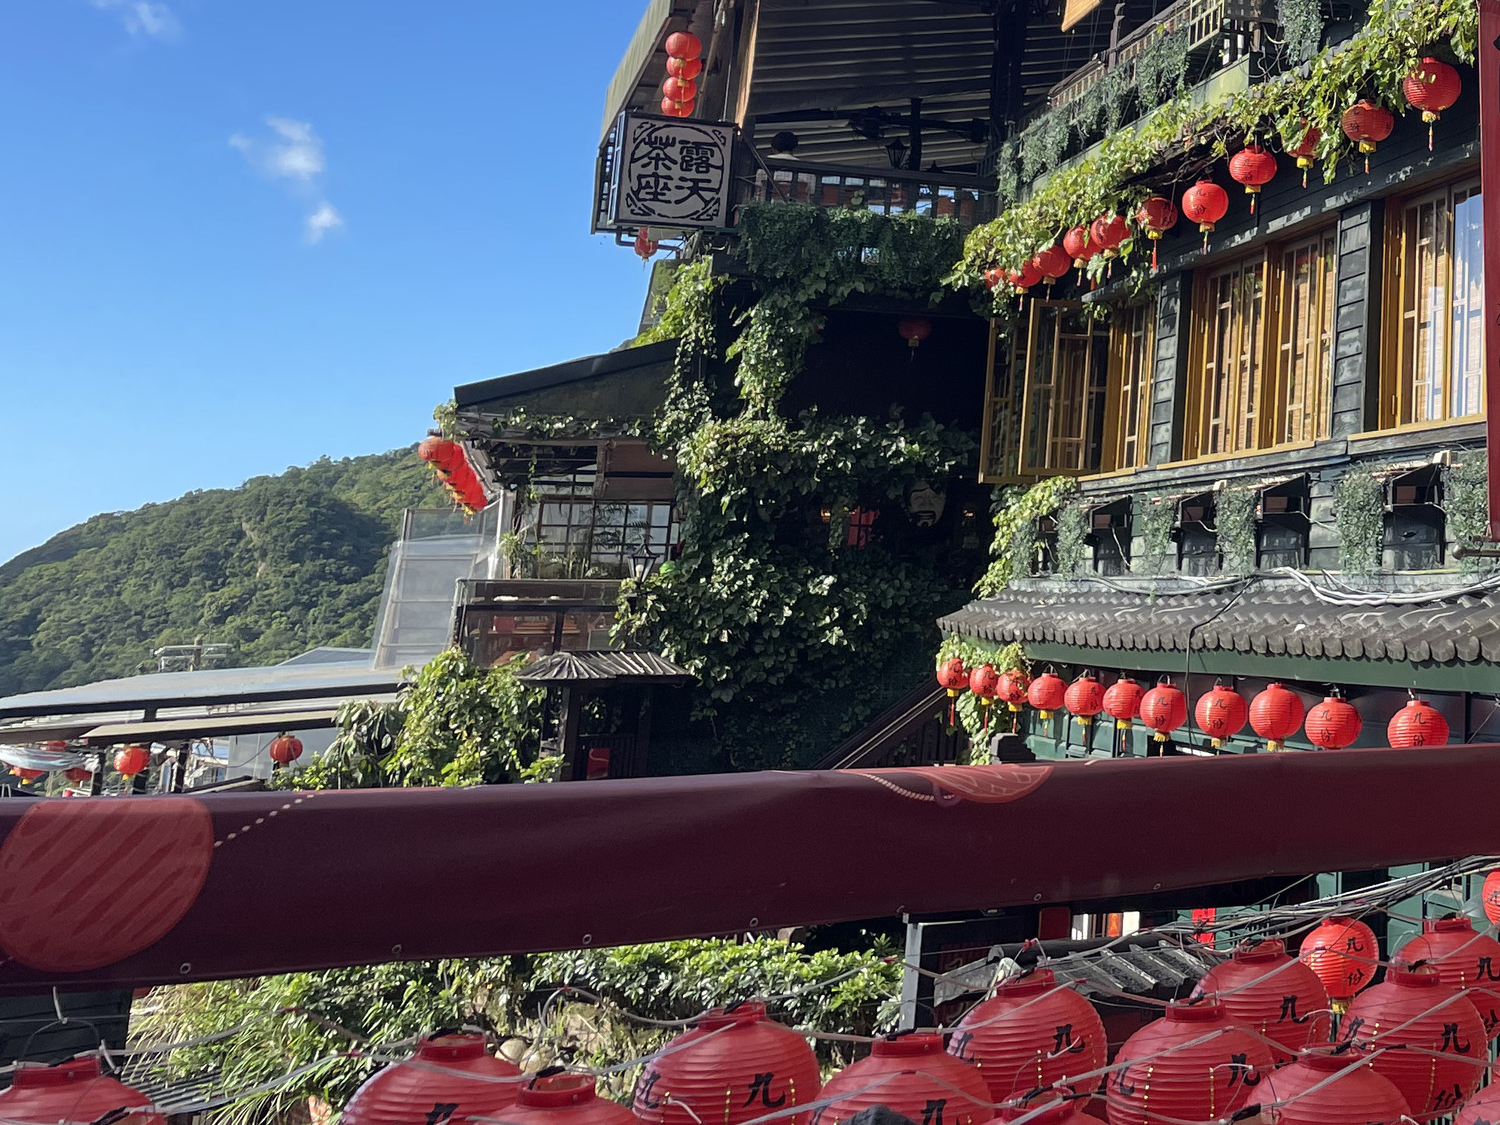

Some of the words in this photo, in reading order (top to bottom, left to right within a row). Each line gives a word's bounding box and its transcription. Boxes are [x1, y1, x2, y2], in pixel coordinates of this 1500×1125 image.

[634, 135, 678, 204] 茶座
[674, 139, 717, 207] 露天
[1052, 1024, 1086, 1054] 九
[1227, 1053, 1261, 1087] 九
[742, 1071, 787, 1109] 九
